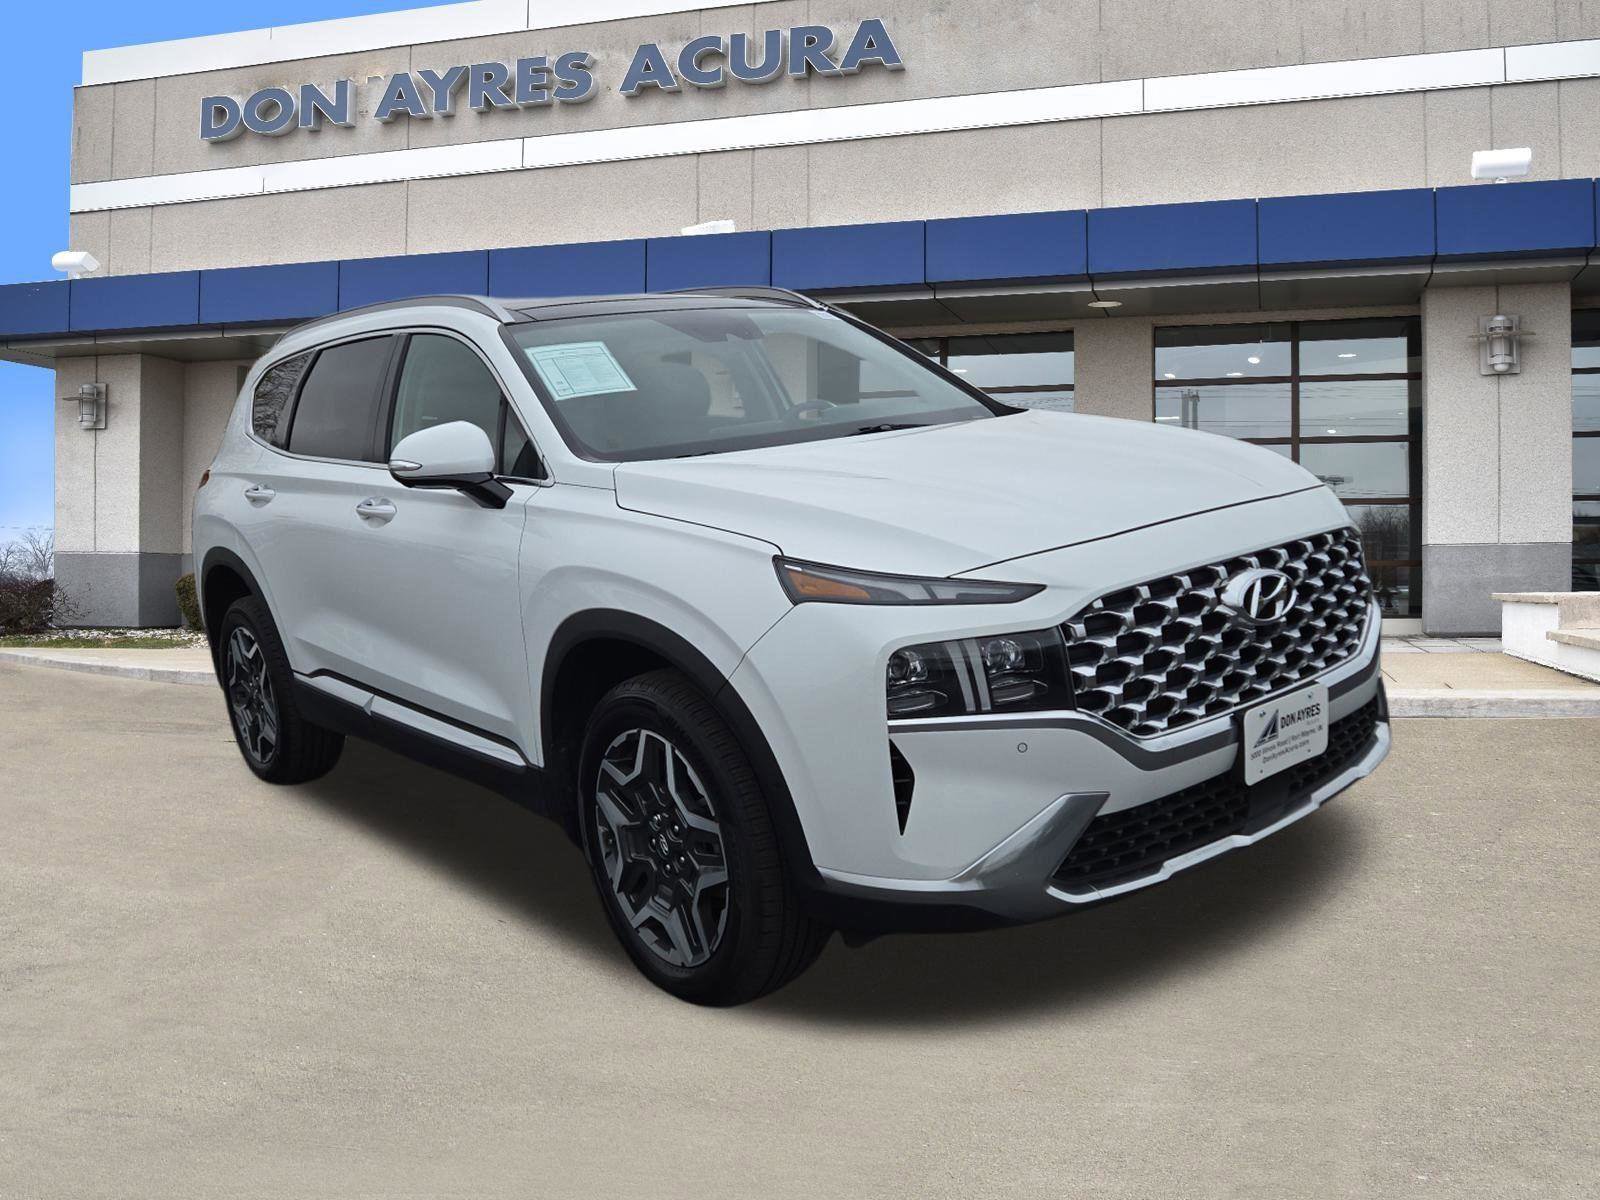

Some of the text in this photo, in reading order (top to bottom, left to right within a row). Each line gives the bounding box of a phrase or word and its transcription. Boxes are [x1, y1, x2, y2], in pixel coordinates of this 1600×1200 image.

[200, 18, 905, 143] DON AYRES ACURA
[1281, 703, 1321, 729] DON AYRES
